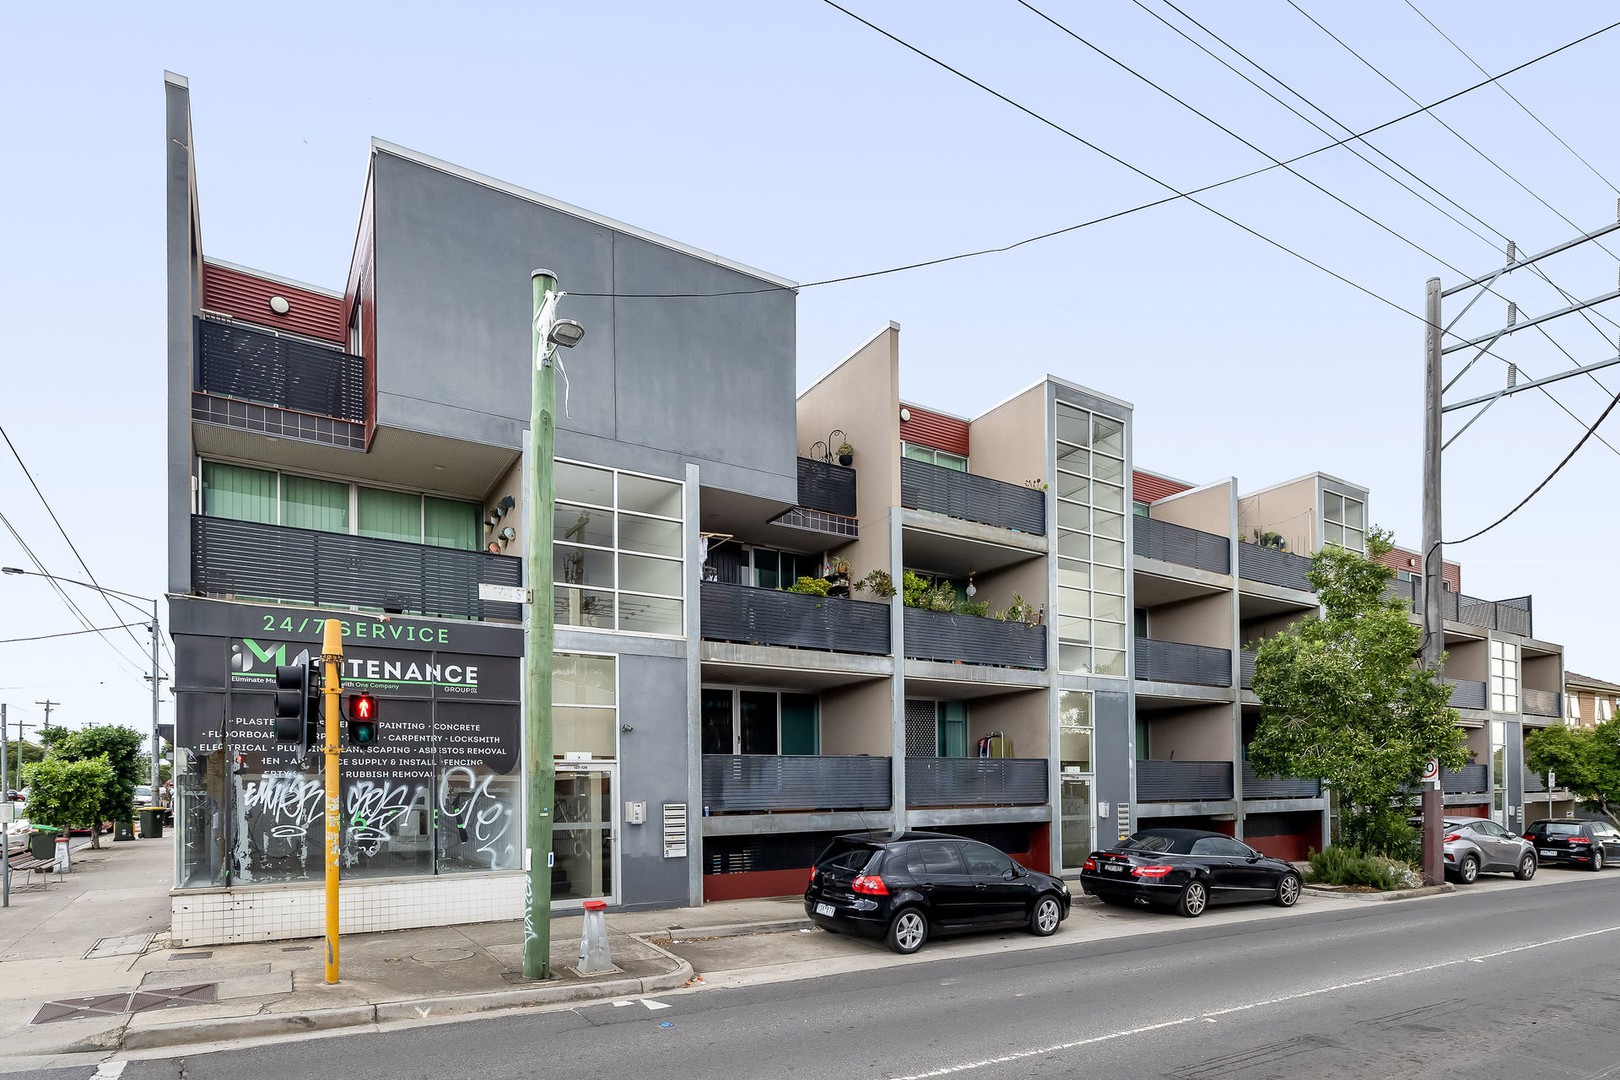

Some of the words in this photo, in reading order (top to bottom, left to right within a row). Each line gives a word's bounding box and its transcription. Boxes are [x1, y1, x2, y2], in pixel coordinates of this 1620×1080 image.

[263, 615, 324, 634] 24/7
[341, 621, 449, 643] SERVICE
[231, 676, 265, 684] Eliminate
[236, 717, 275, 726] PLASTE
[379, 722, 426, 730] PAINTING
[433, 723, 481, 732] CONCRETE
[388, 734, 443, 742] CARPENTRY
[449, 735, 500, 743] LOCKSMITH
[199, 742, 268, 752] ELECTRICAL
[341, 745, 411, 754] LANSCAPING
[467, 747, 507, 755] REMOVAL
[351, 758, 388, 766] SUPPLY
[390, 758, 397, 766] &
[399, 758, 437, 766] INSTALL
[345, 770, 389, 778] RUBBISH
[392, 770, 435, 778] REMOVAL
